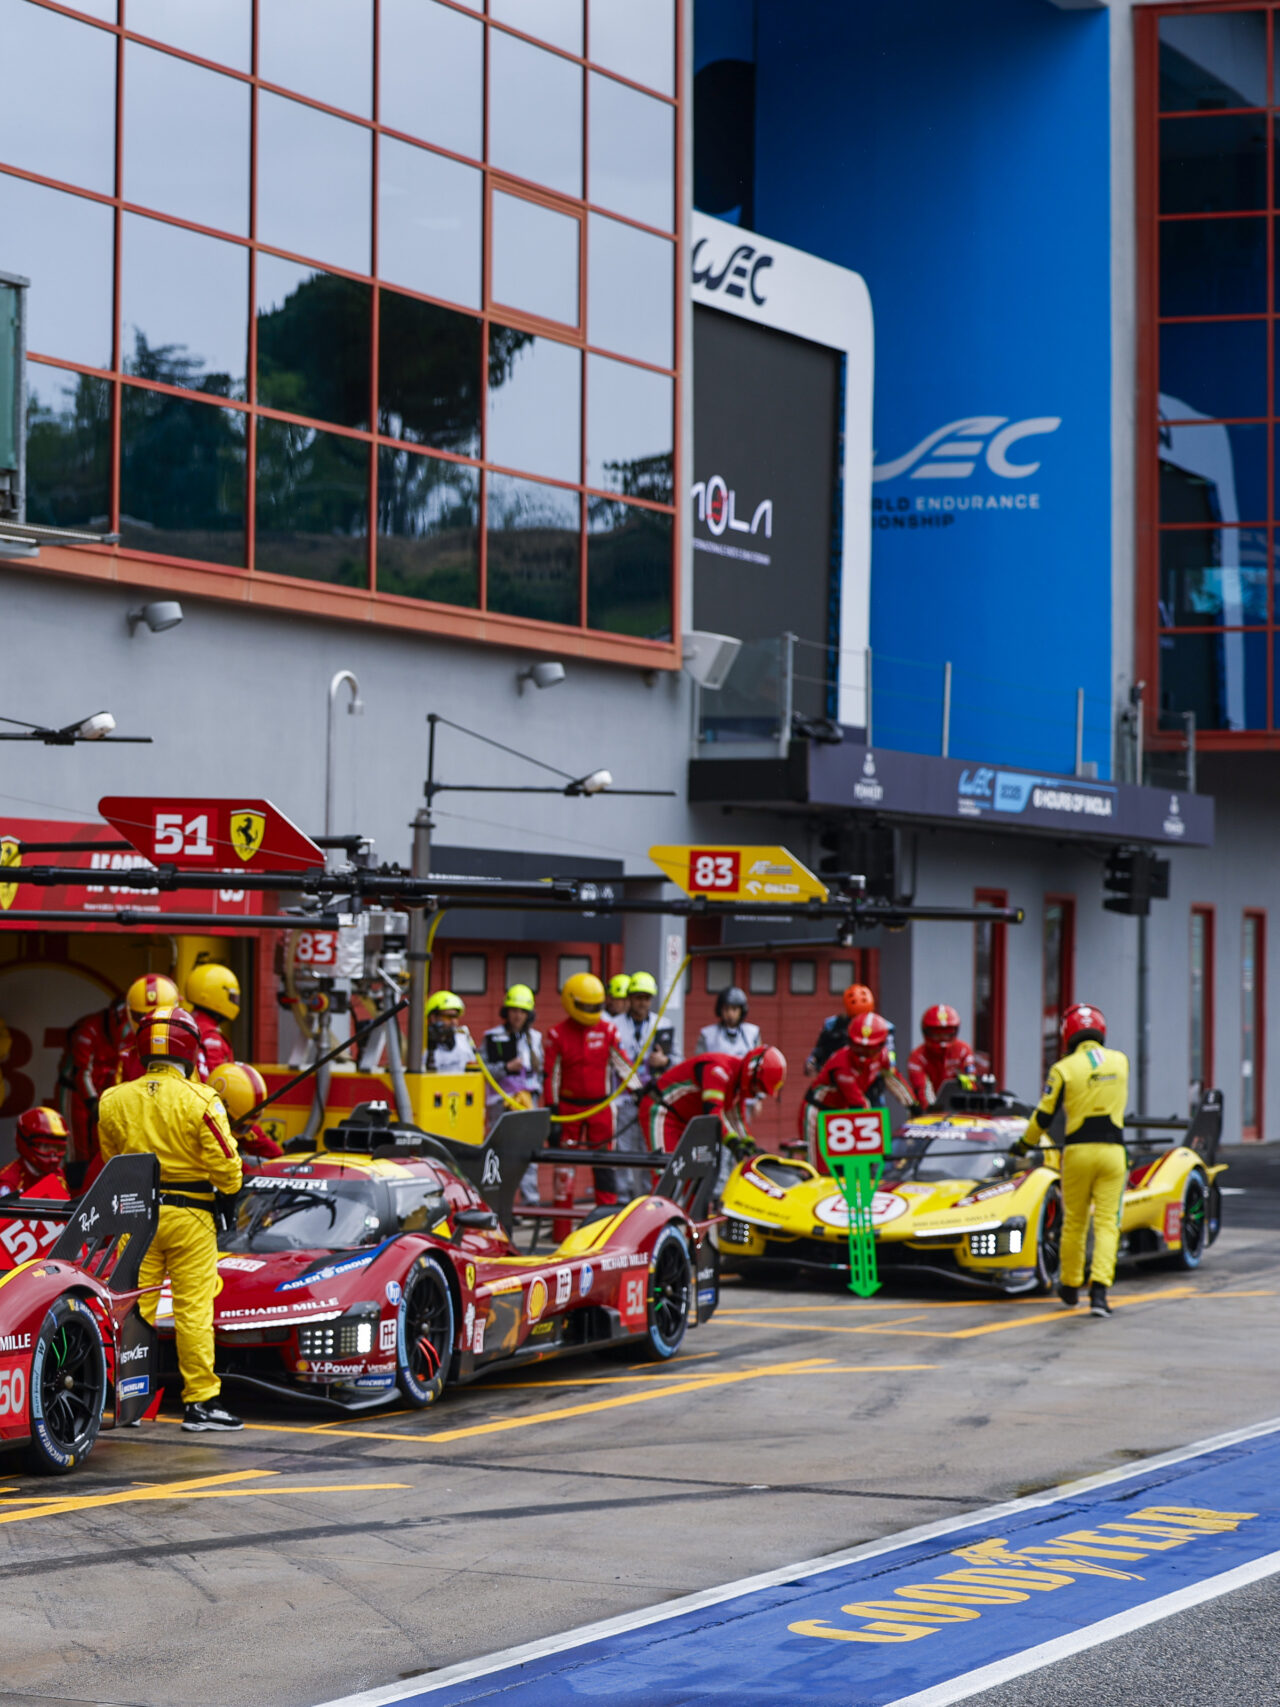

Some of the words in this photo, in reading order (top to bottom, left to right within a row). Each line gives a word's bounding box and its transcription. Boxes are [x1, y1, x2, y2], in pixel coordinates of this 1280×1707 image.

[693, 238, 773, 306] WEC
[915, 493, 1040, 511] ENDURANCE
[154, 813, 214, 856] 51
[695, 856, 734, 887] 83
[296, 932, 333, 962] 83
[827, 1116, 881, 1152] 83
[244, 1176, 329, 1191] Ferrari
[0, 1219, 68, 1266] 51
[282, 1275, 320, 1291] ADLER
[335, 1257, 374, 1274] GROUP
[601, 1255, 629, 1272] RICHARD
[629, 1252, 649, 1266] MILLE
[220, 1305, 289, 1319] RICHARD
[293, 1297, 339, 1312] MILLE
[626, 1280, 645, 1316] 51
[0, 1333, 31, 1352] MILLE
[311, 1360, 364, 1374] V-Power
[37, 1423, 66, 1465] MICHELIN
[787, 1506, 1261, 1643] GOODYEAR
